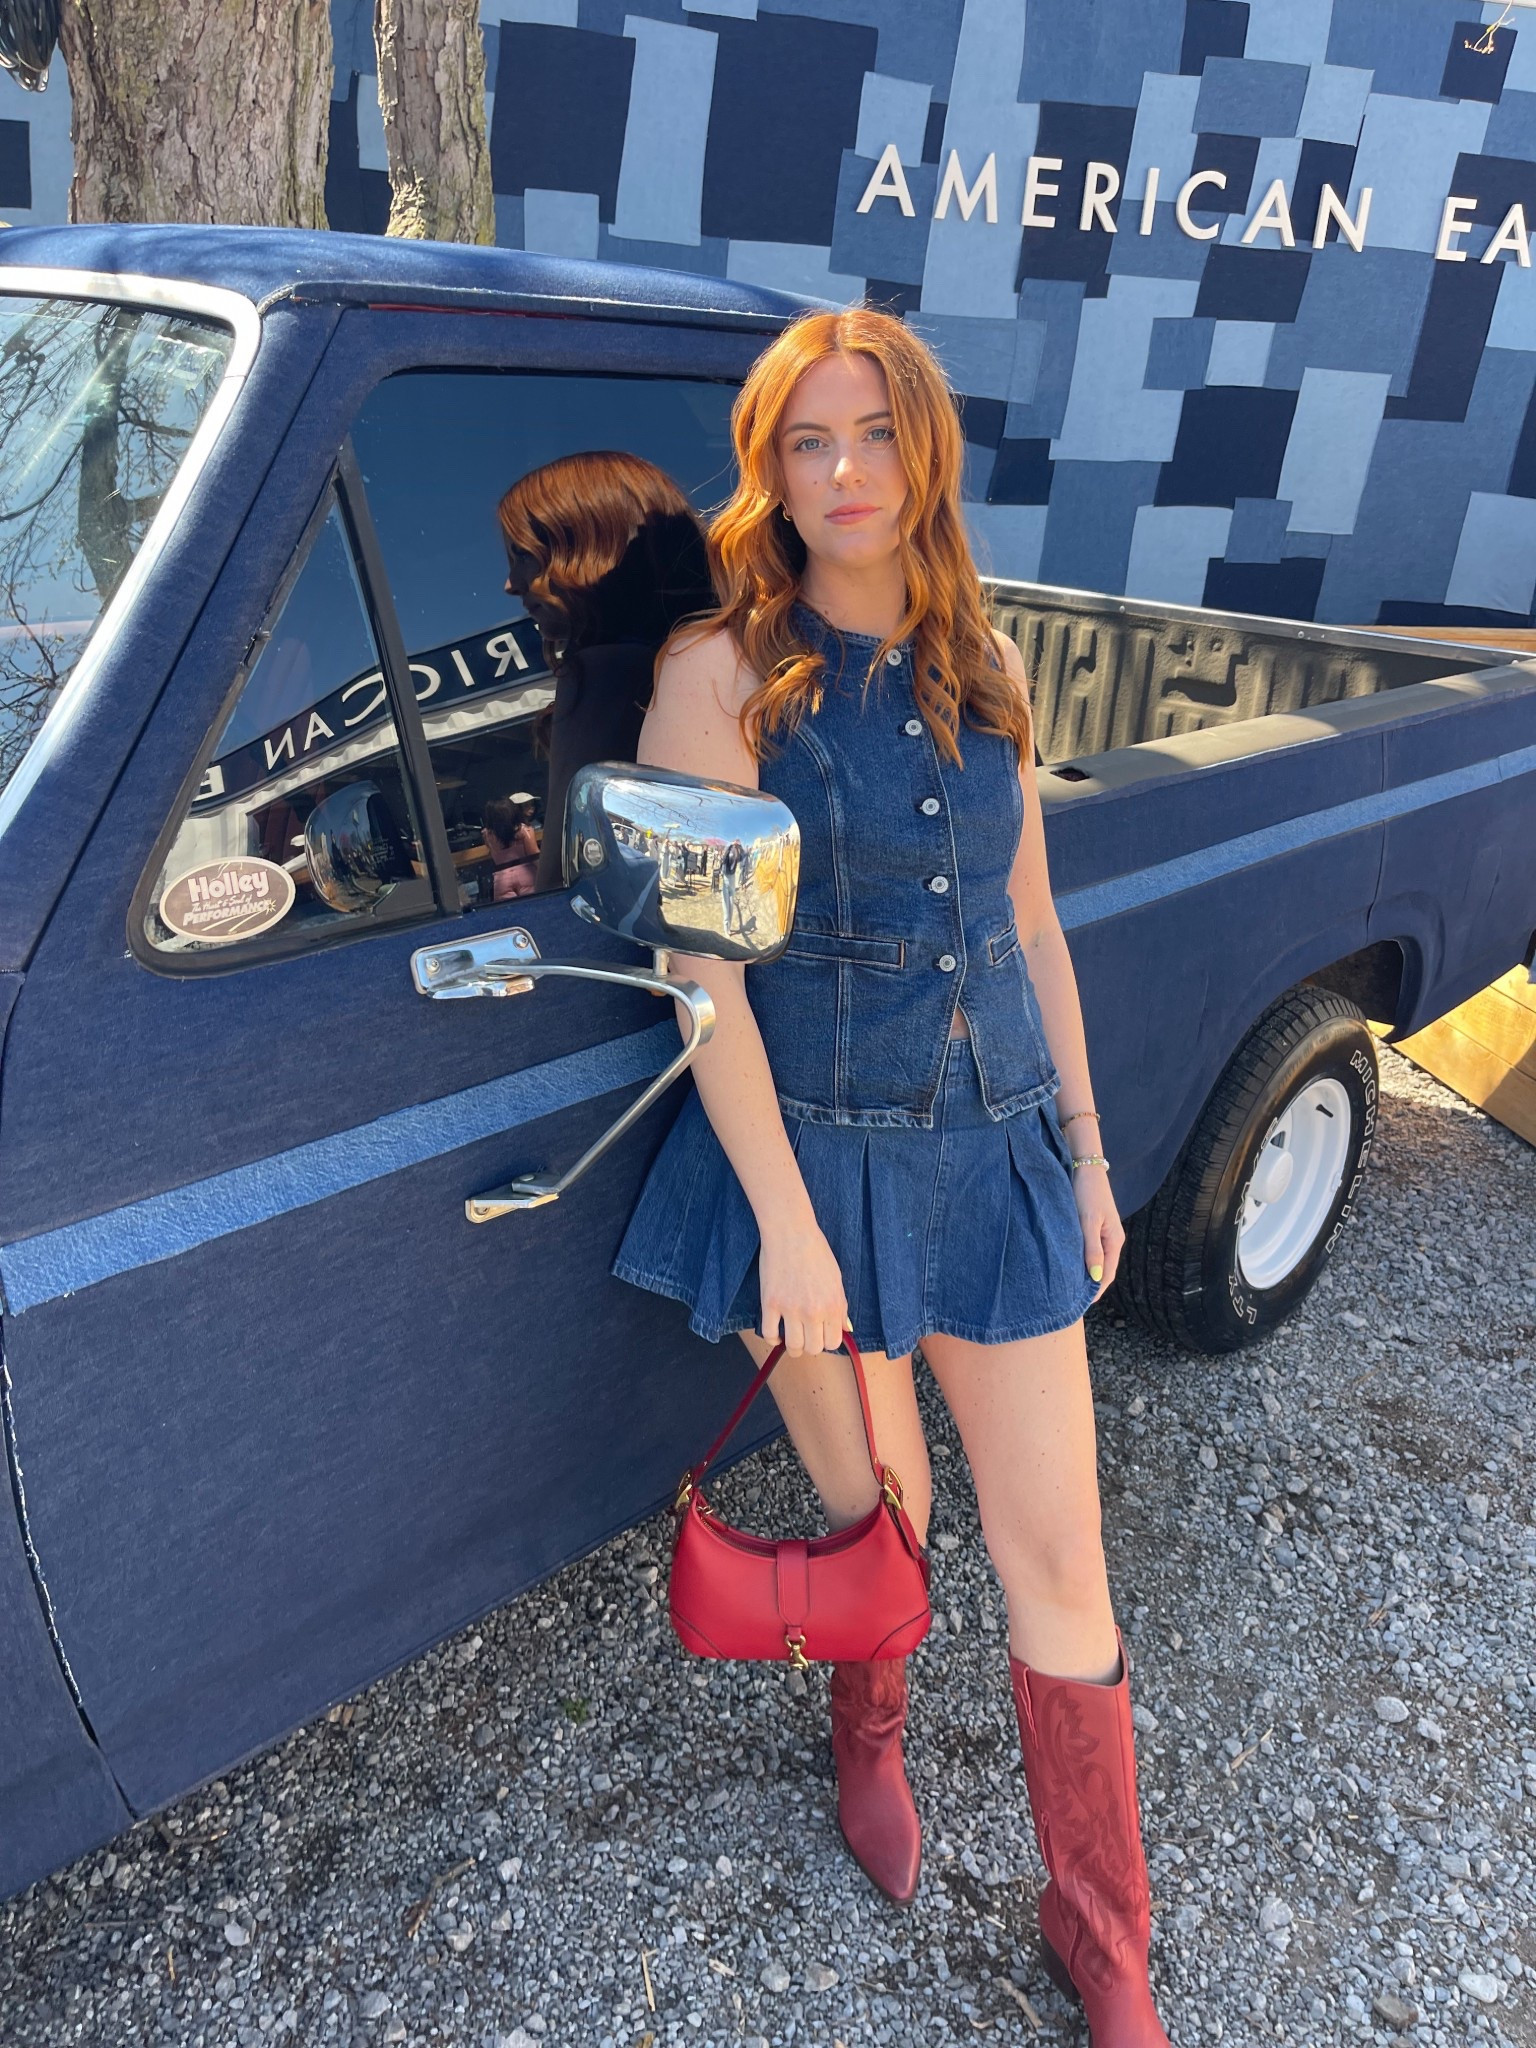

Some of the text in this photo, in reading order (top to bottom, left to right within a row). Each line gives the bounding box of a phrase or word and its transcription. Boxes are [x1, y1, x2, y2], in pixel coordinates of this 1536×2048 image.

[856, 144, 1532, 268] AMERICAN EA
[188, 871, 270, 903] Holley
[1325, 1050, 1377, 1254] MICHELIN
